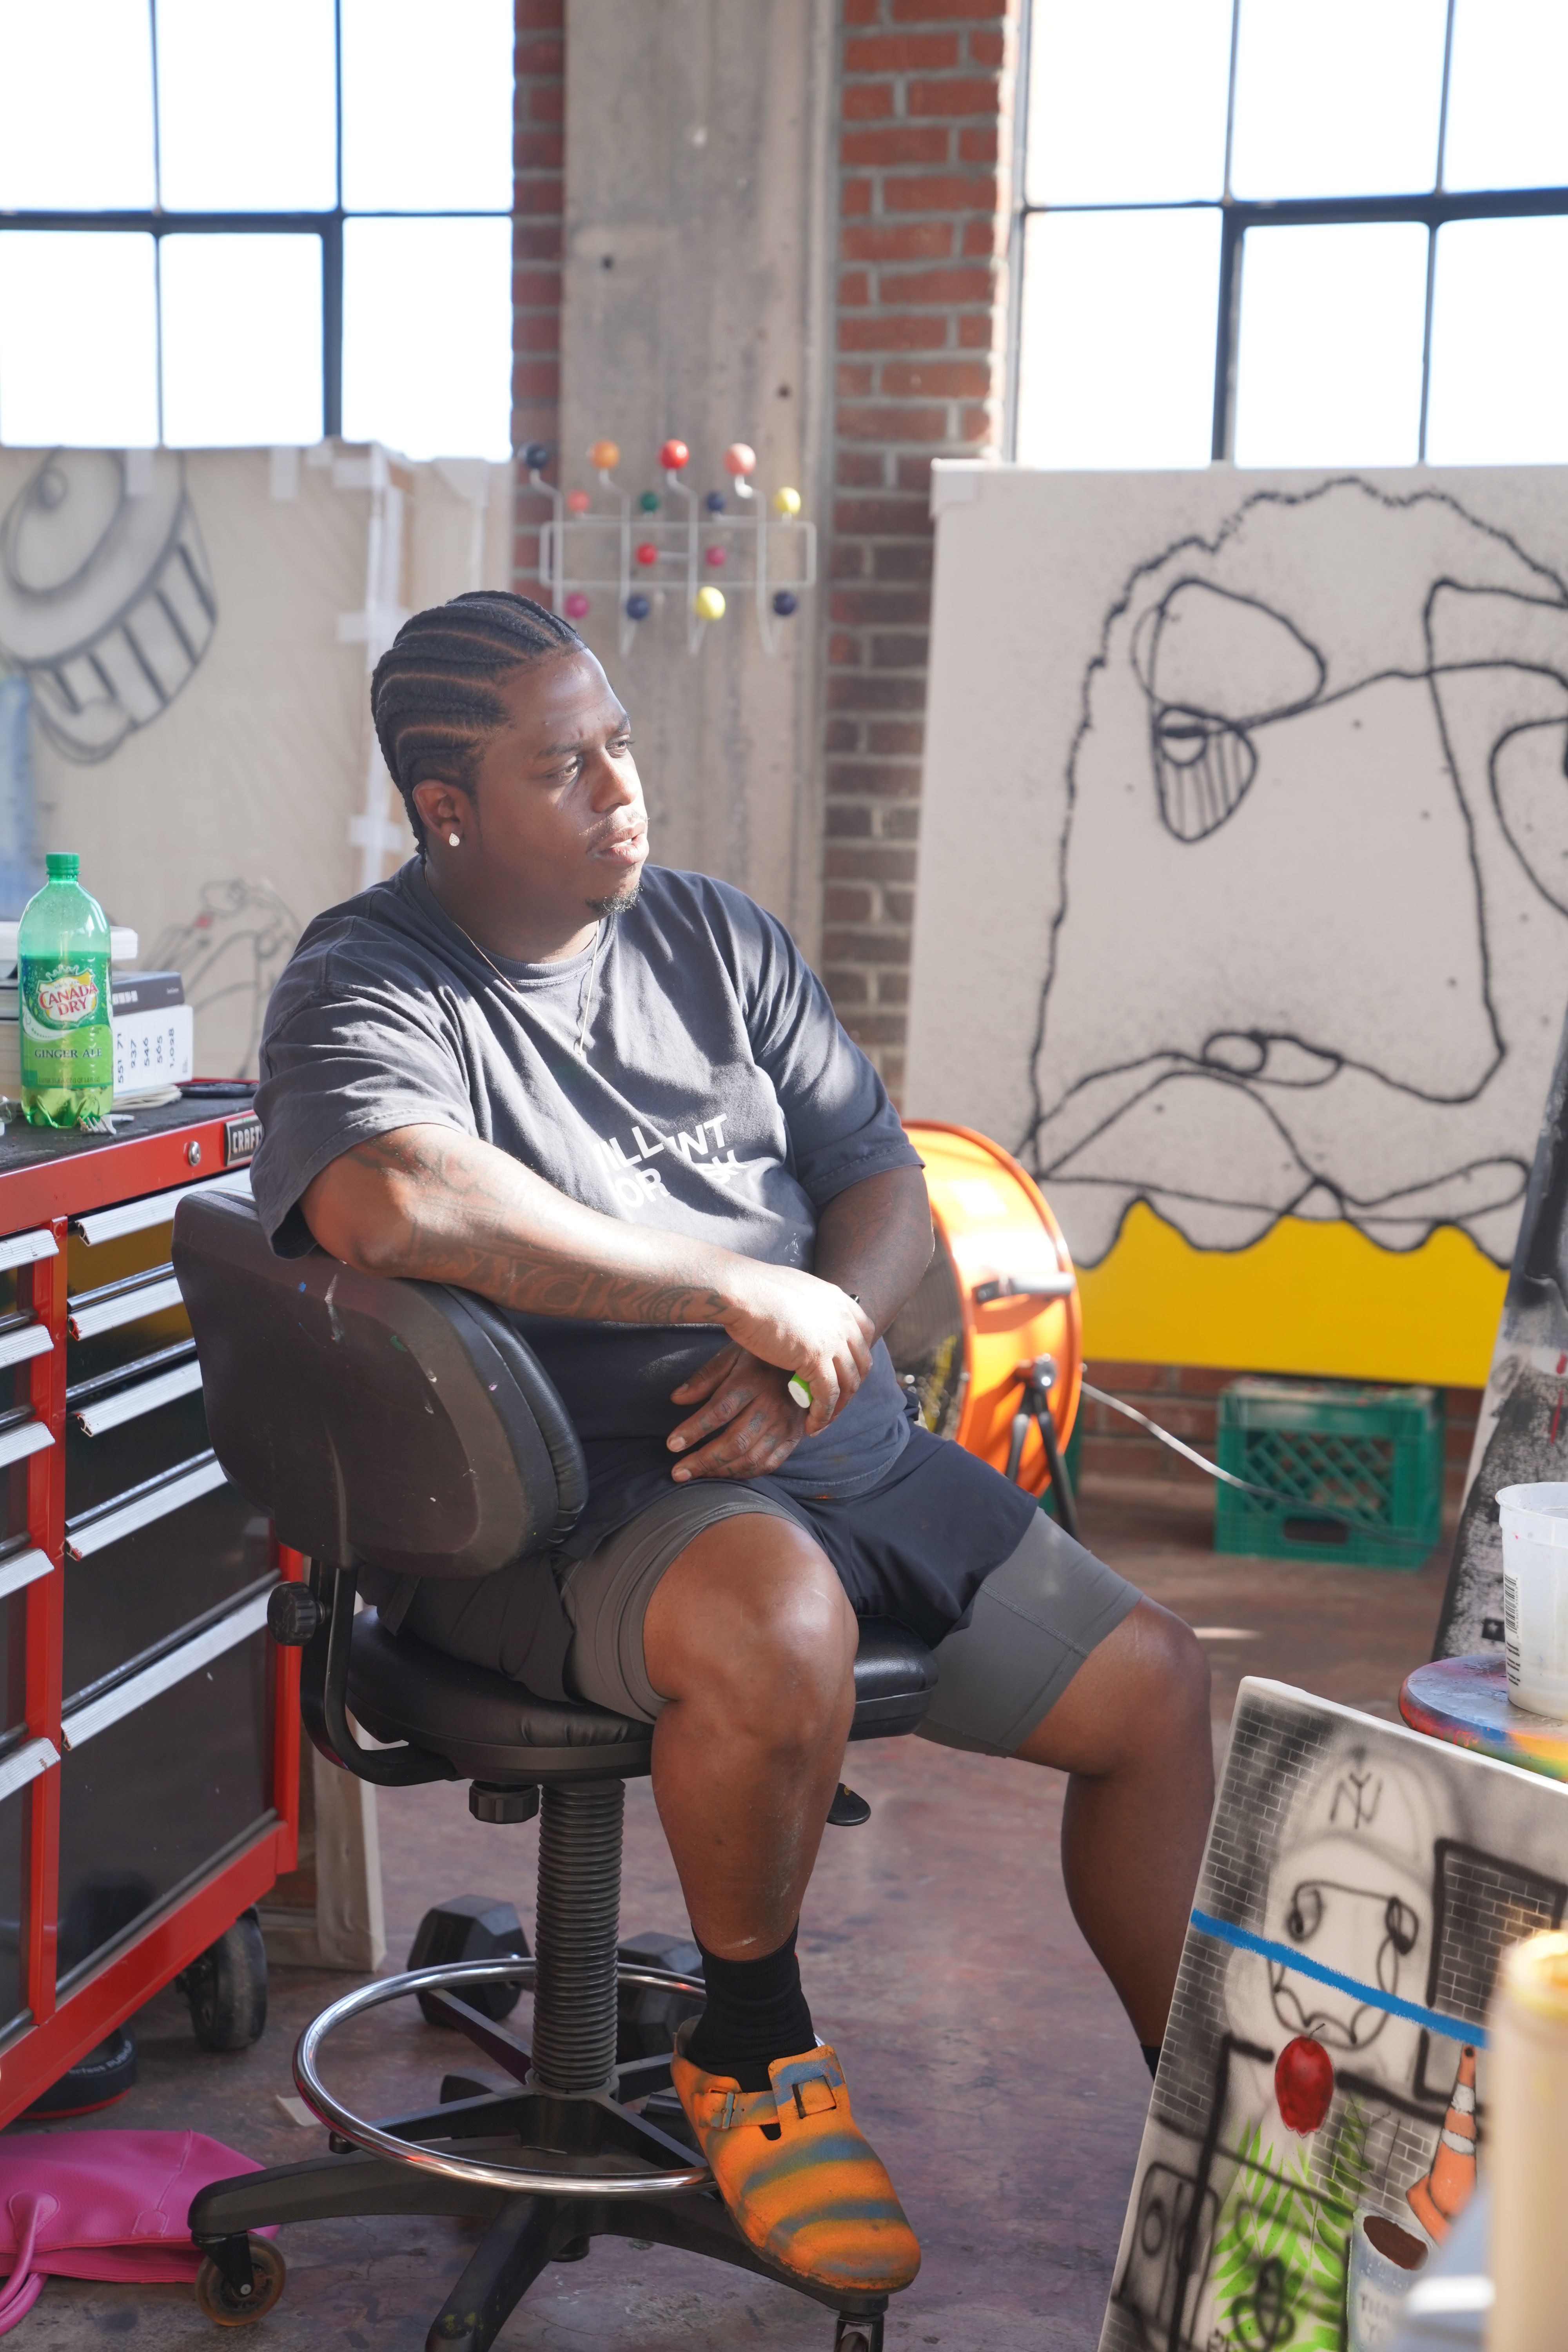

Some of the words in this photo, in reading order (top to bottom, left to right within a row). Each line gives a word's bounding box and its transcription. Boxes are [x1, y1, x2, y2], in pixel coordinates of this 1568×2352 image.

[39, 982, 98, 1009] CANADA
[58, 997, 87, 1016] DRY
[117, 1033, 123, 1049] 71
[34, 1048, 78, 1058] GINGER
[83, 1048, 102, 1058] ALE
[232, 1124, 262, 1154] CRAFT
[666, 1113, 728, 1161] INT
[612, 1168, 671, 1208] OR
[67, 2065, 106, 2075] erfect
